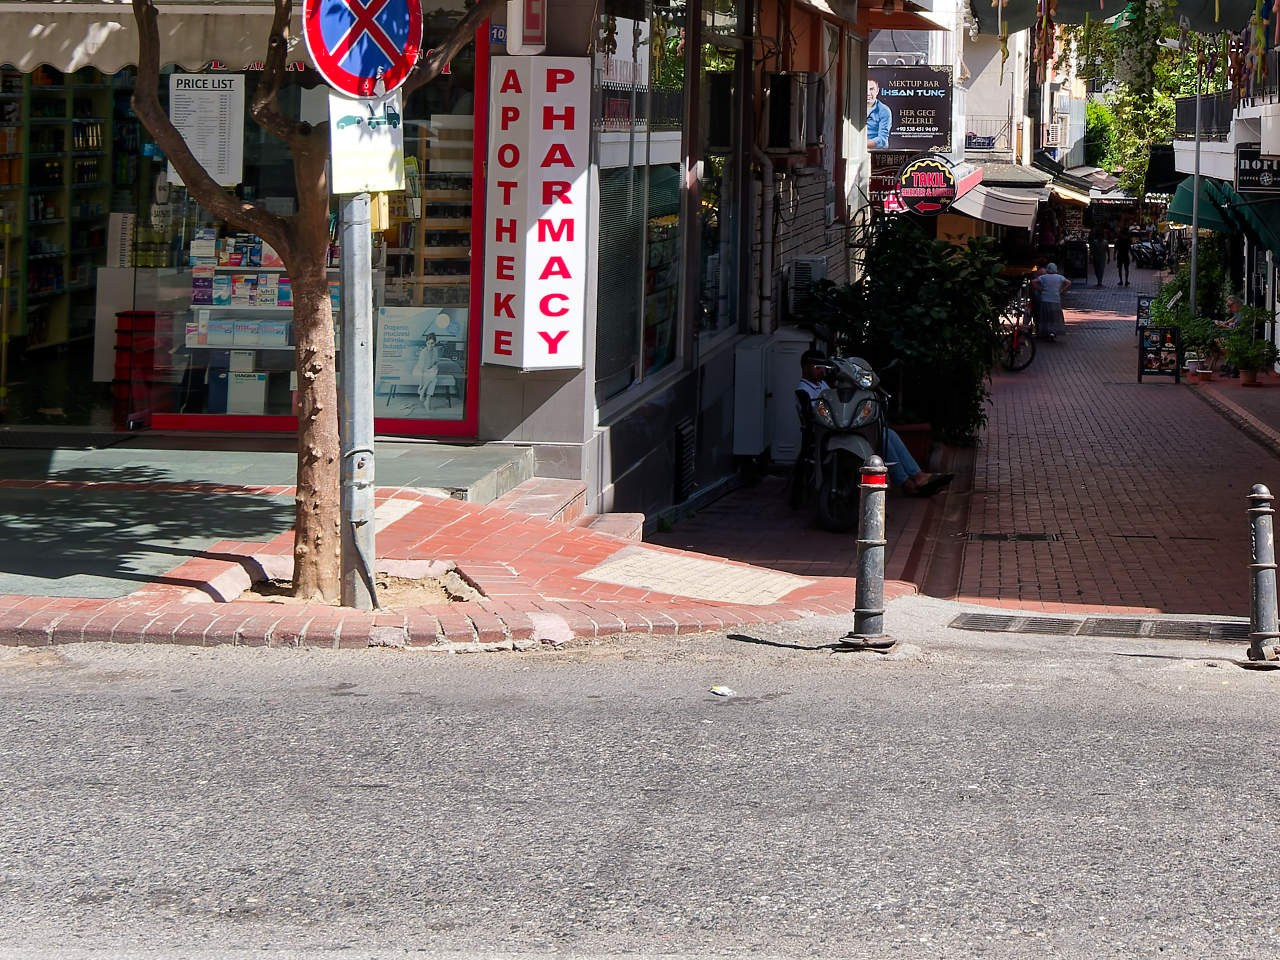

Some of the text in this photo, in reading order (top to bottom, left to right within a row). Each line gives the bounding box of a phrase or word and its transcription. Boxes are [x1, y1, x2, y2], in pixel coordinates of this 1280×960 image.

[175, 78, 235, 89] PRICE LIST
[917, 109, 936, 117] GECE
[912, 172, 947, 187] TAKIL
[493, 68, 523, 355] APOTHEKE
[537, 68, 576, 355] PHARMACY
